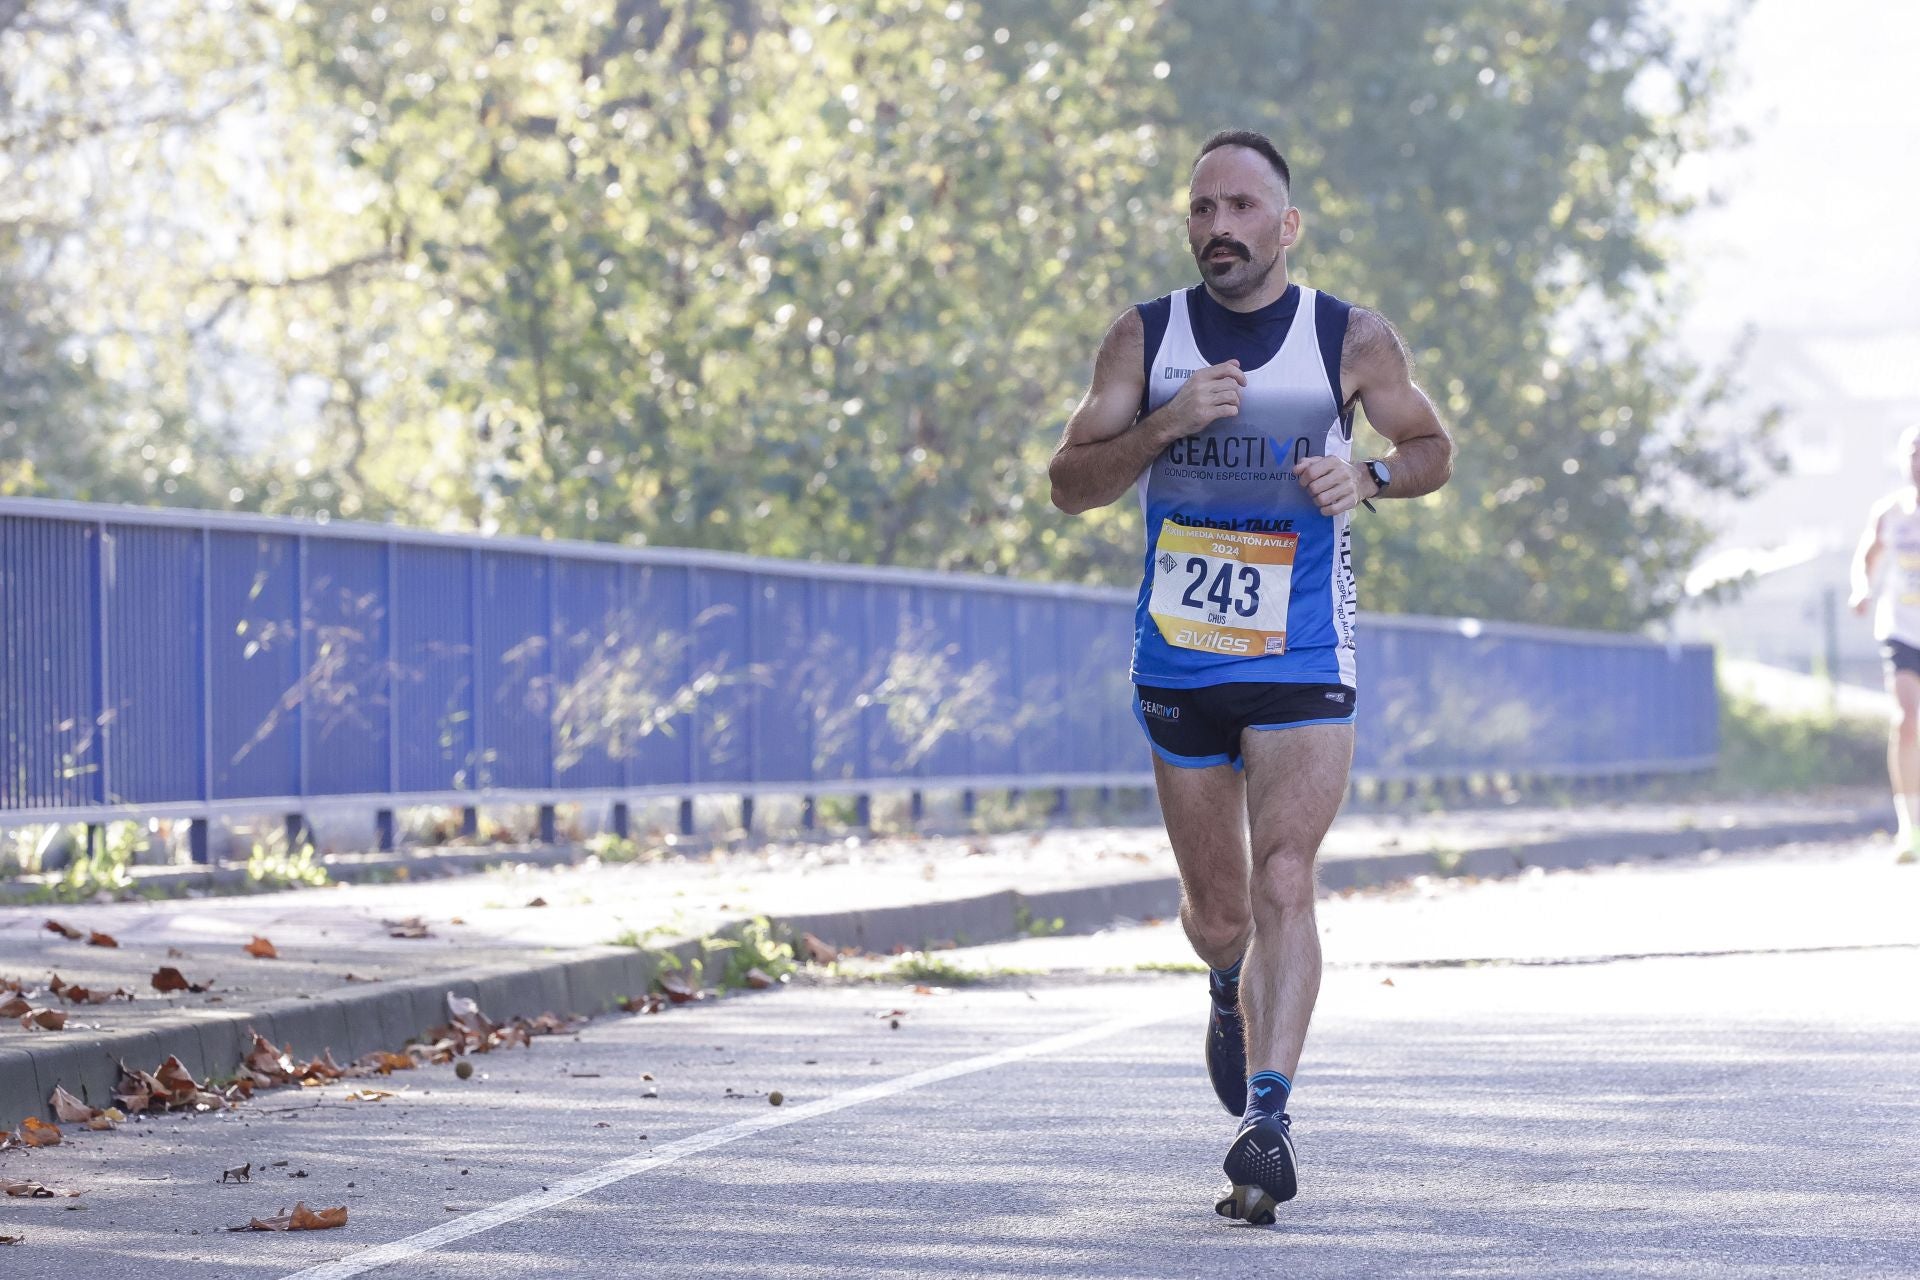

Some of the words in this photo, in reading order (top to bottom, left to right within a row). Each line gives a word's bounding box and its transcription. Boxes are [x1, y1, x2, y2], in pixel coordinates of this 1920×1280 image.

[1169, 436, 1310, 468] CEACTIVO
[1216, 471, 1267, 481] ESPECTRO
[1186, 530, 1215, 540] MEDIA
[1216, 532, 1262, 546] MARATÓN
[1263, 538, 1296, 549] AVILÉS
[1211, 543, 1240, 556] 2024
[1181, 557, 1261, 618] 243
[1207, 612, 1227, 625] CHUS
[1140, 699, 1180, 719] CEACTIVO
